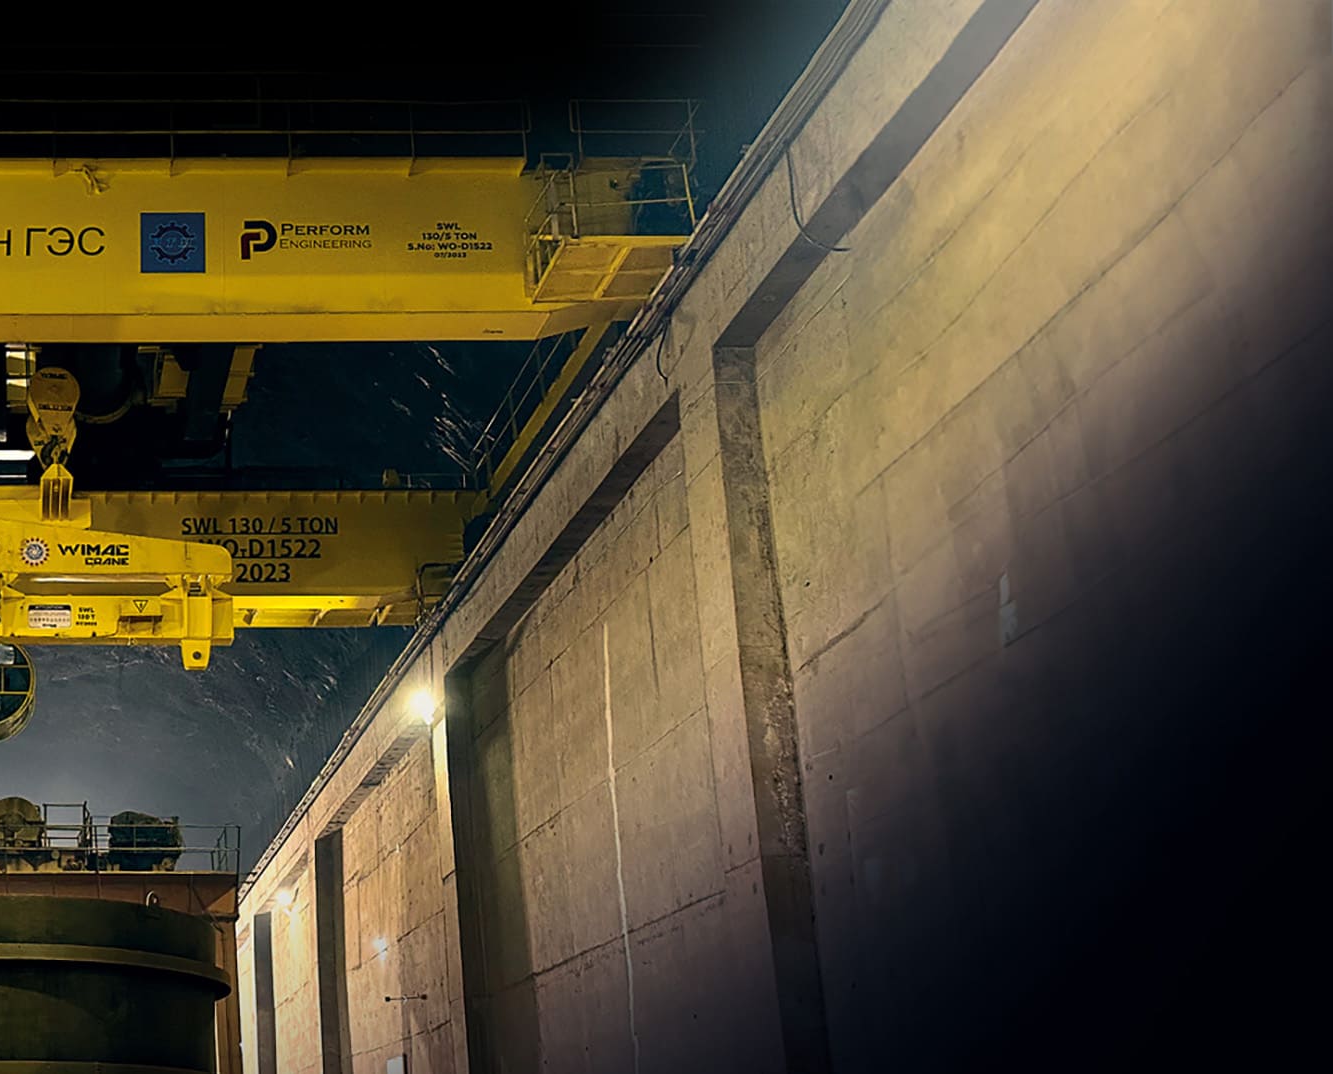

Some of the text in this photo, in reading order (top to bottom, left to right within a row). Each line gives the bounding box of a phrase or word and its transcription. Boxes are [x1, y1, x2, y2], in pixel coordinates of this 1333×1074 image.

[281, 223, 370, 236] PERFORM
[25, 227, 106, 257] ГЭС
[454, 232, 477, 240] TON
[279, 239, 372, 249] ENGINEERING
[438, 242, 492, 250] WO-D1522
[181, 518, 338, 534] SWL 130 / 5 TON
[57, 544, 129, 556] WIMAC
[236, 563, 291, 582] 2023
